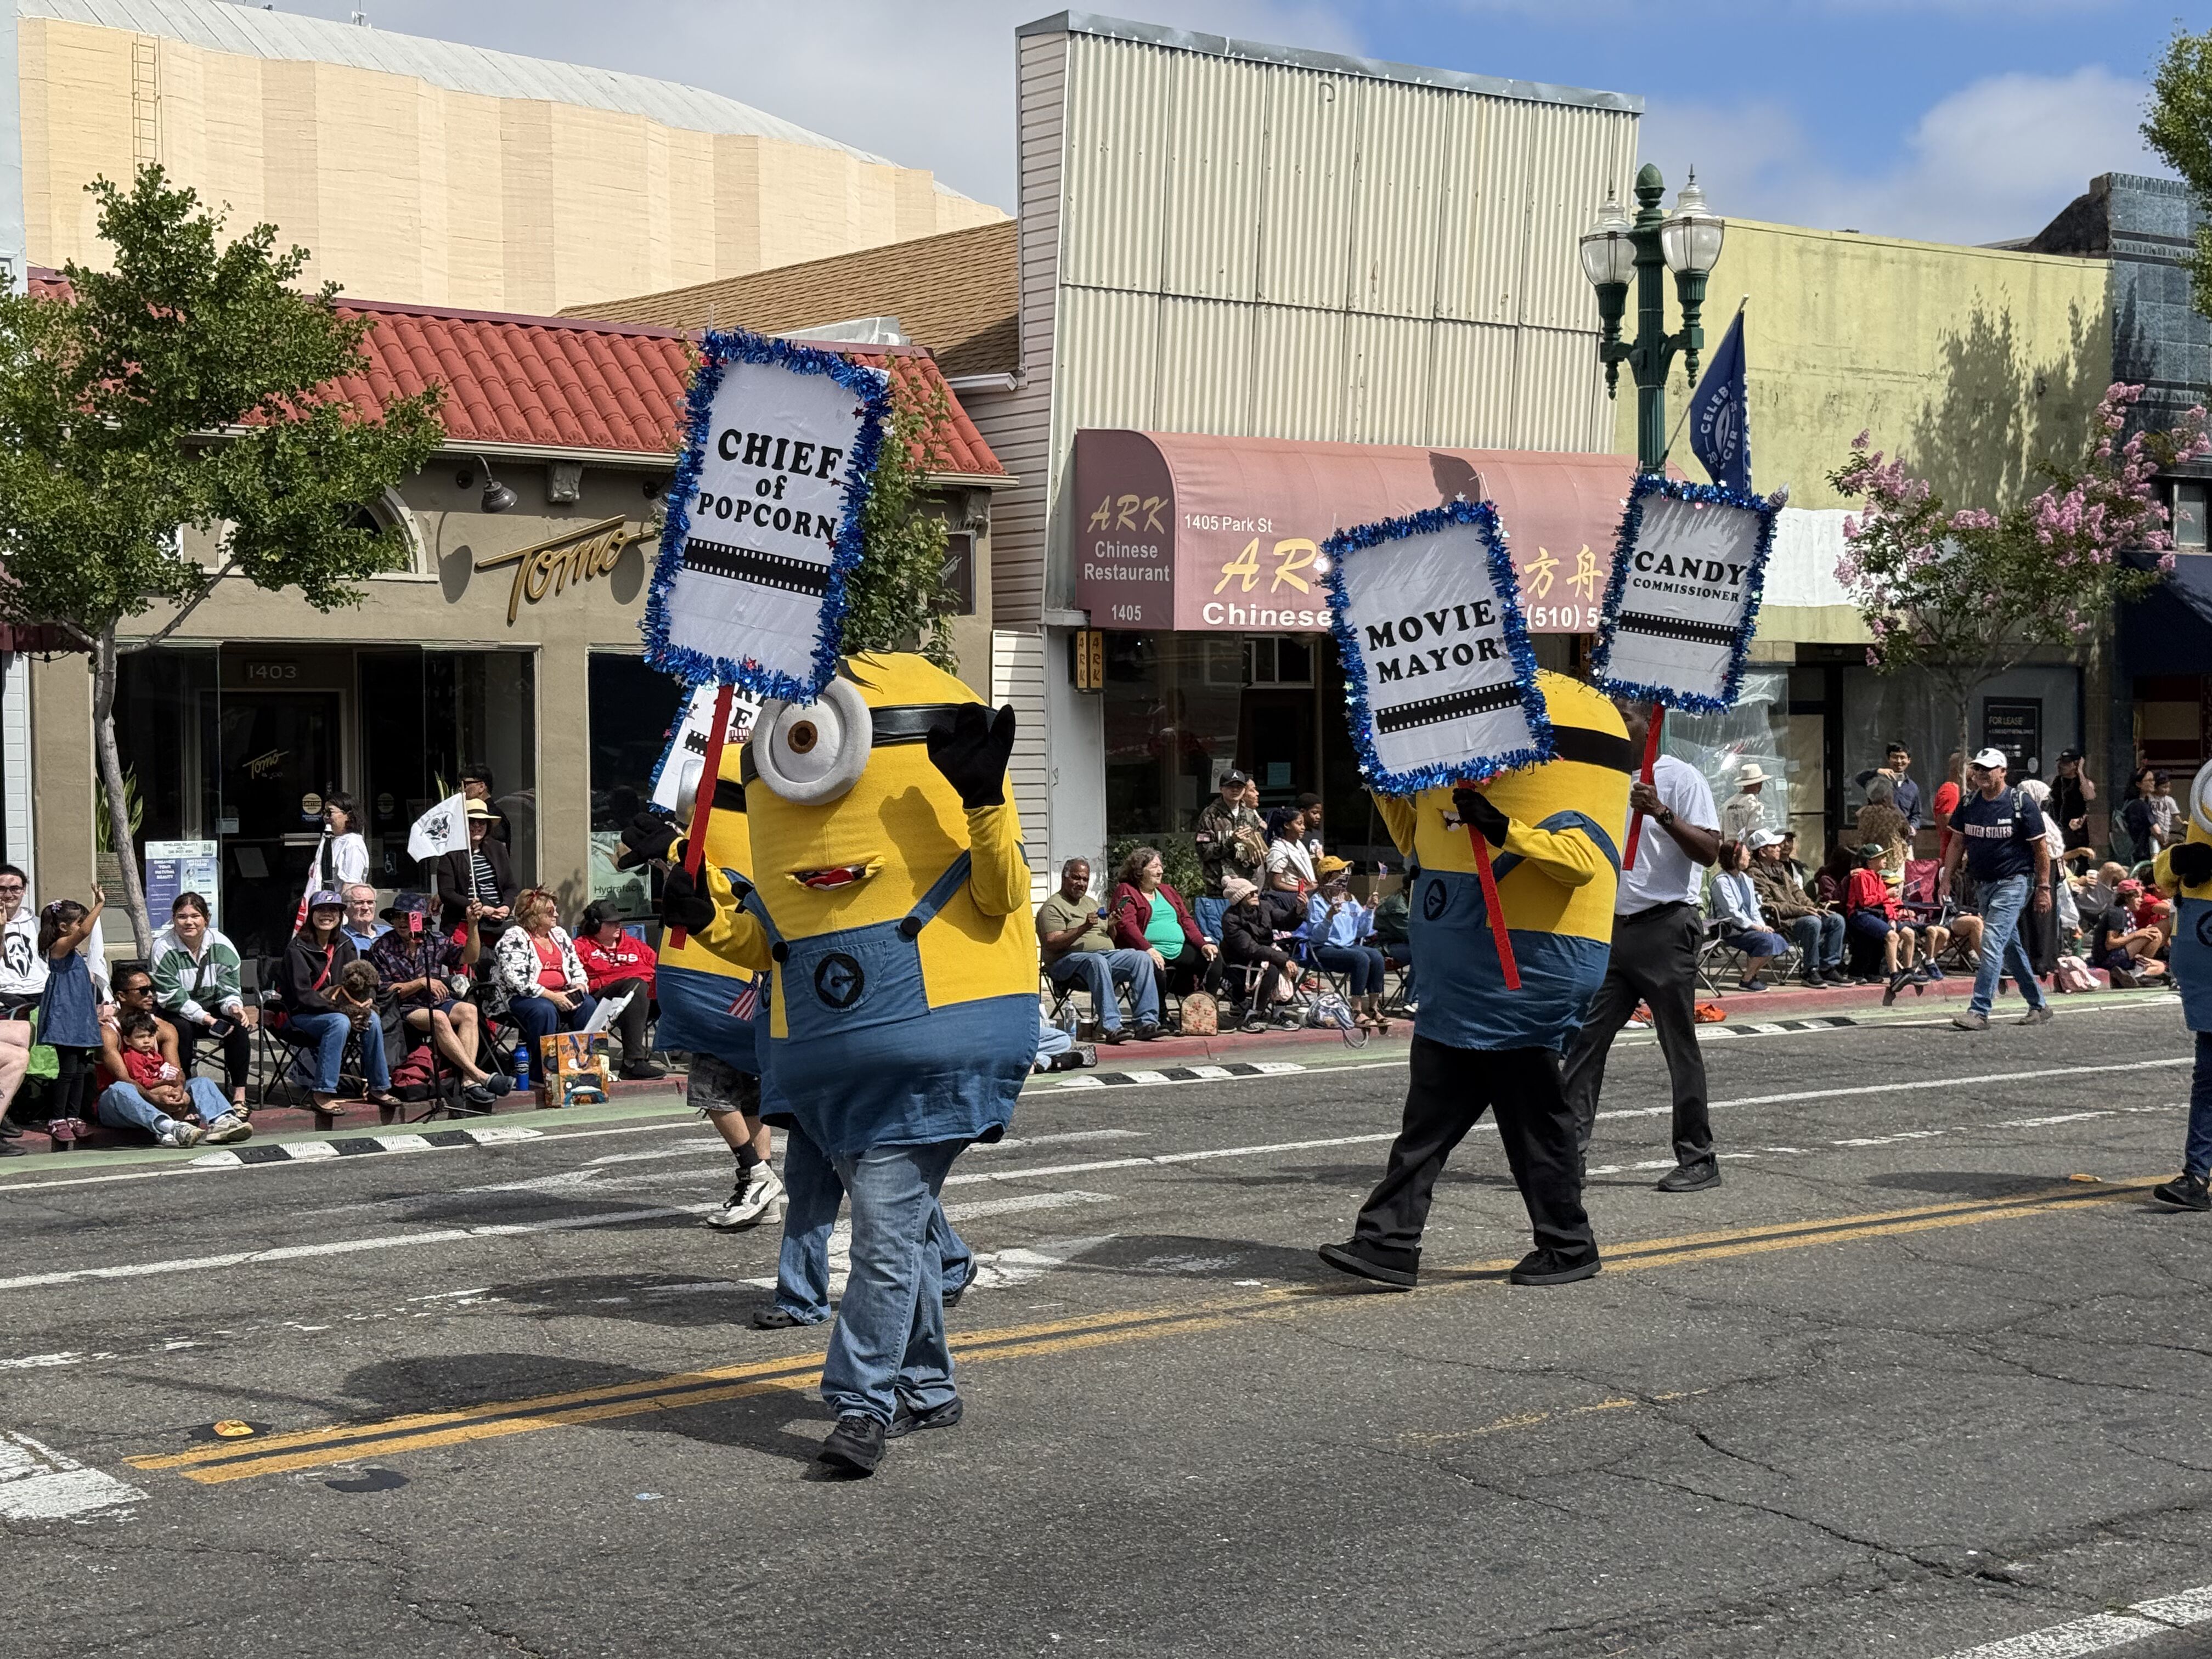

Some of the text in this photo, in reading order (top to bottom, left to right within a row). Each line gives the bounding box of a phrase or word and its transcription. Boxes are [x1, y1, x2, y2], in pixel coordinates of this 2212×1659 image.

[718, 429, 843, 479] CHIEF
[1707, 452, 1718, 464] 20
[755, 475, 787, 500] of
[696, 492, 838, 541] POPCORN
[1087, 494, 1169, 534] ARK
[1184, 514, 1272, 533] 1405 Park St
[1095, 540, 1158, 559] Chinese
[477, 514, 656, 622] Tomo
[1085, 563, 1170, 582] Restaurant
[1213, 537, 1317, 595] AR
[1523, 544, 1604, 602] 方舟
[1634, 551, 1747, 585] CANDY
[1633, 578, 1739, 602] COMMISSIONER
[1111, 605, 1142, 621] 1405
[1203, 602, 1333, 627] Chinese
[1365, 599, 1496, 651] MOVIE
[1527, 603, 1580, 630] (510)
[250, 665, 297, 679] 1403
[1375, 638, 1500, 684] MAYOR
